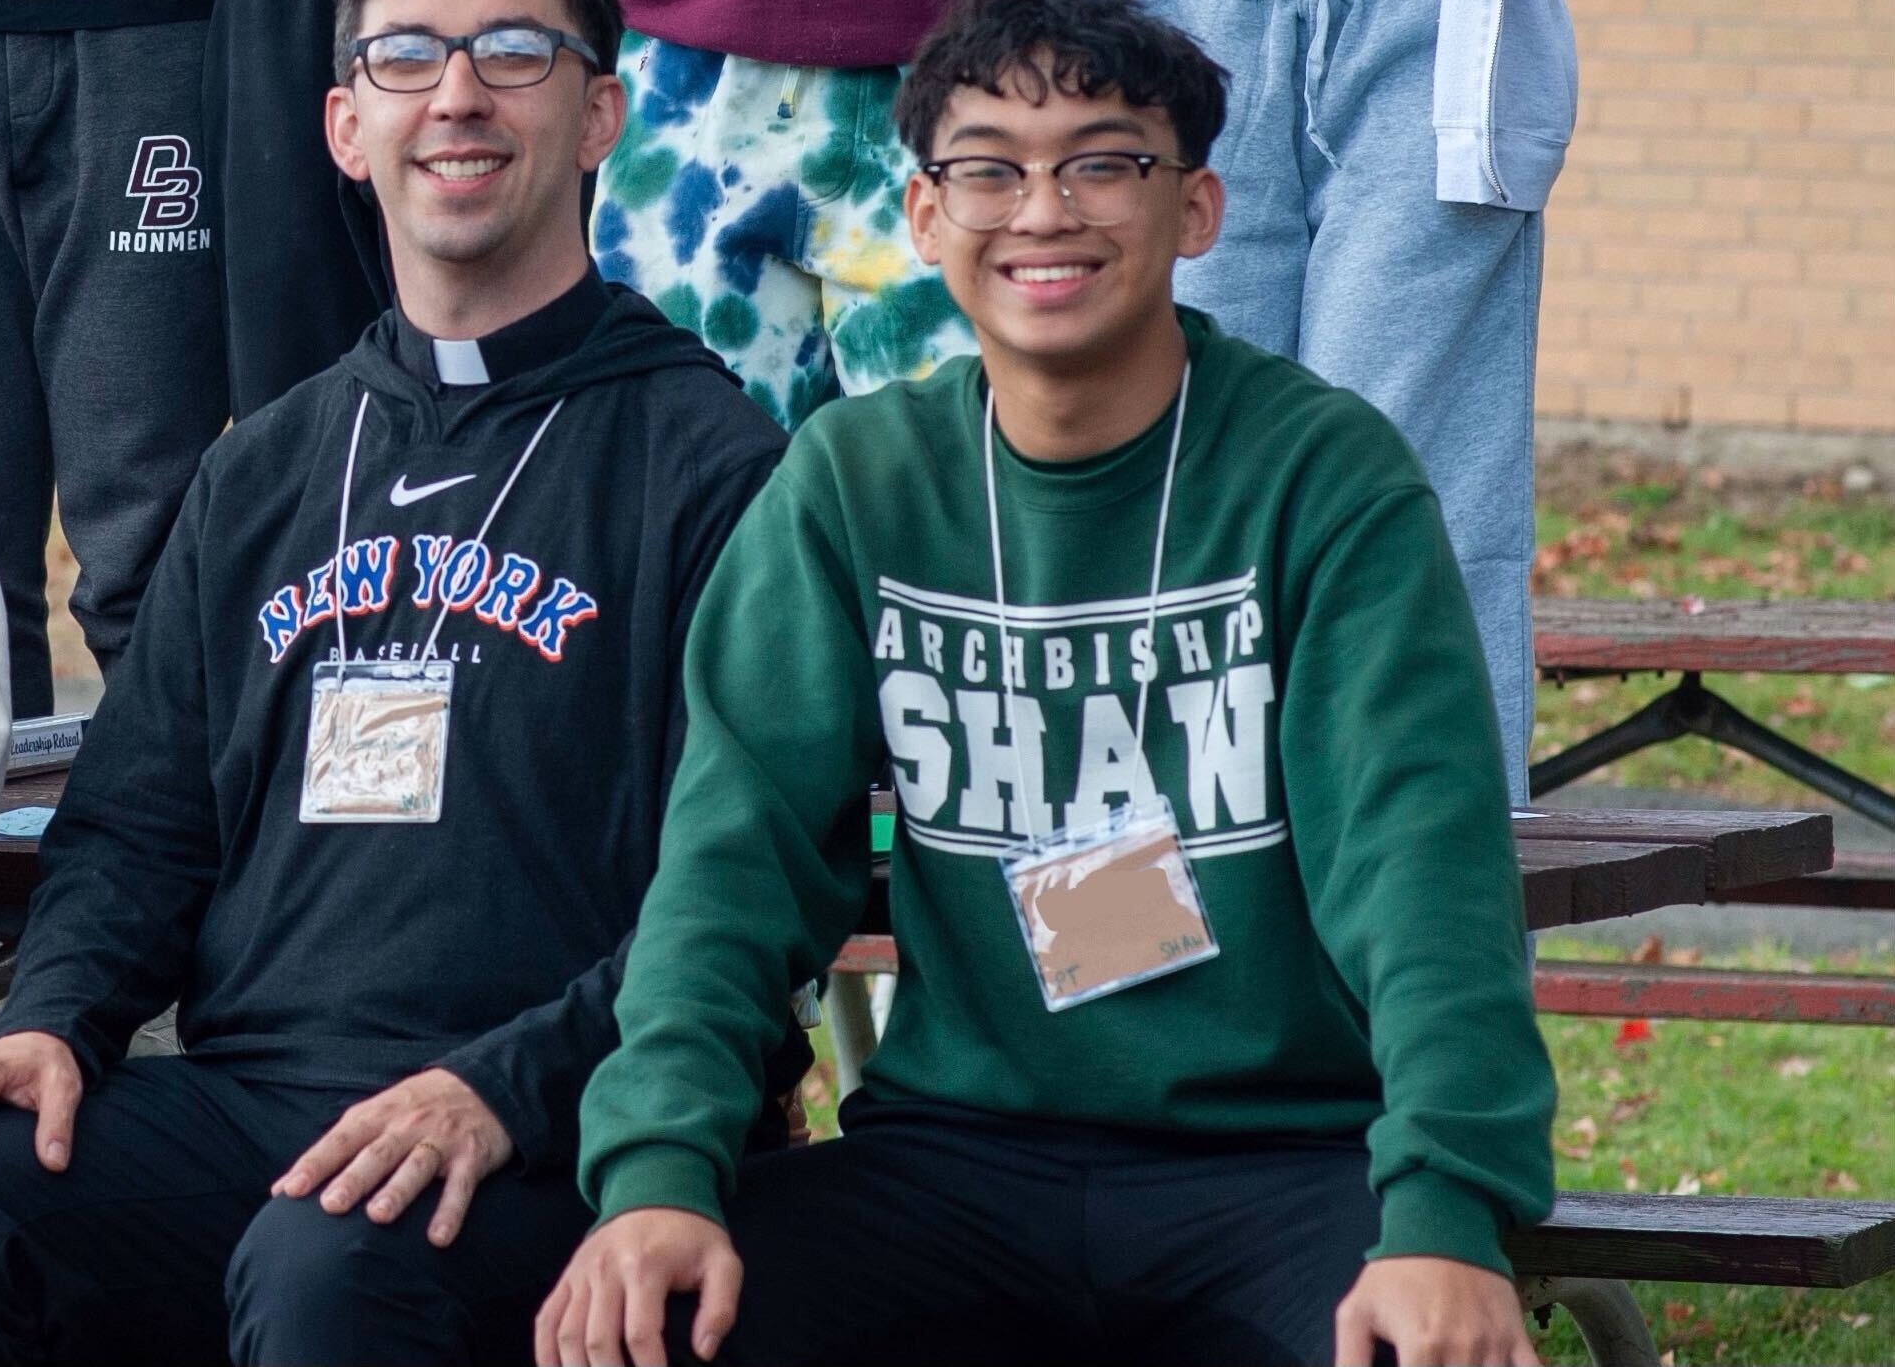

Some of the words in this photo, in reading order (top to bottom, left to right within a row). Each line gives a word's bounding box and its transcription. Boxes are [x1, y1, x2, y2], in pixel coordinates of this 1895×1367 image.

[126, 135, 202, 230] DB
[109, 228, 210, 253] IRONMEN
[258, 535, 399, 663] NEW
[412, 534, 598, 662] YORK
[52, 731, 80, 750] Retreat
[878, 662, 1275, 836] SHAW
